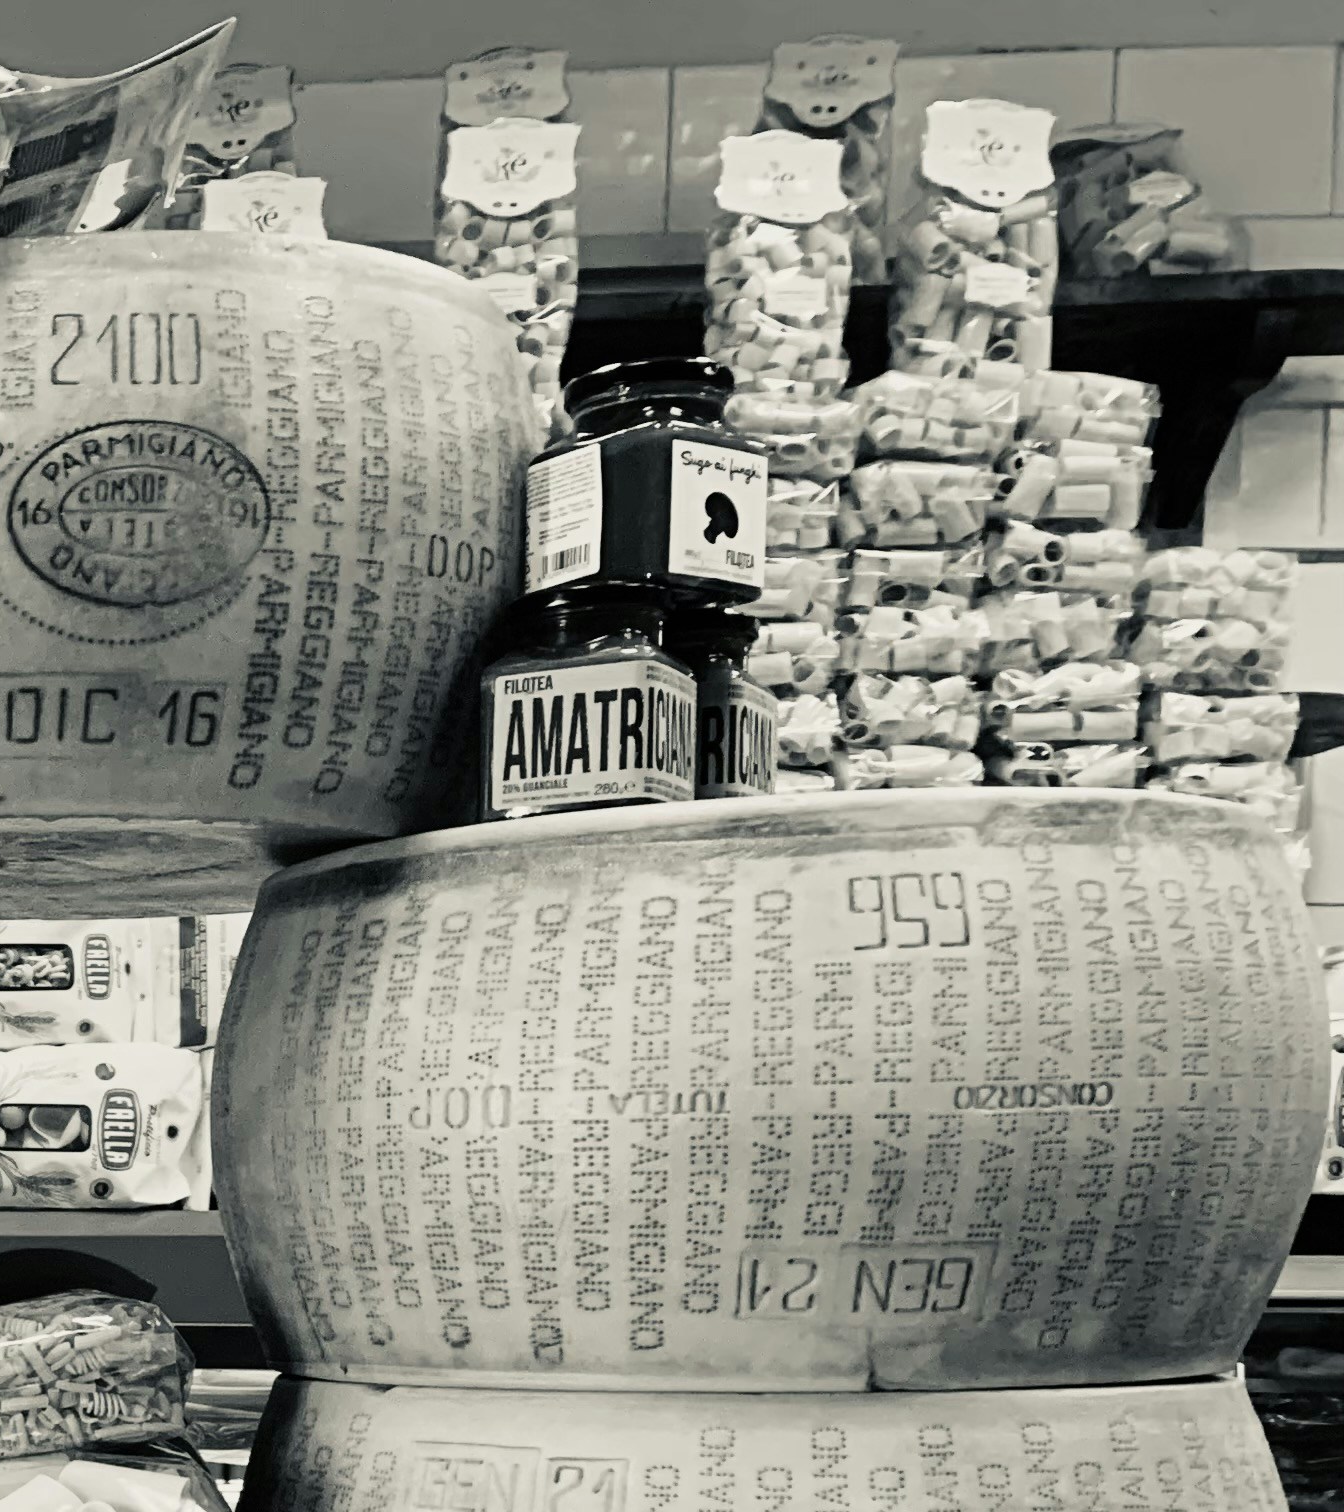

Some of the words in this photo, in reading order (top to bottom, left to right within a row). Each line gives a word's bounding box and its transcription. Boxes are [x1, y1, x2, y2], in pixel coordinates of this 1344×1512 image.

[50, 313, 201, 385] 2100
[40, 433, 249, 486] PARMIGIANO
[16, 499, 53, 530] 16
[504, 674, 553, 695] FILOTEA
[6, 687, 119, 744] DIC
[159, 689, 221, 747] 16
[502, 686, 692, 782] AMATRICIANA
[609, 1086, 730, 1117] TUTELA
[955, 1081, 1113, 1111] CONSORZIO
[101, 1095, 137, 1164] FAELLA
[853, 1256, 973, 1314] GEN
